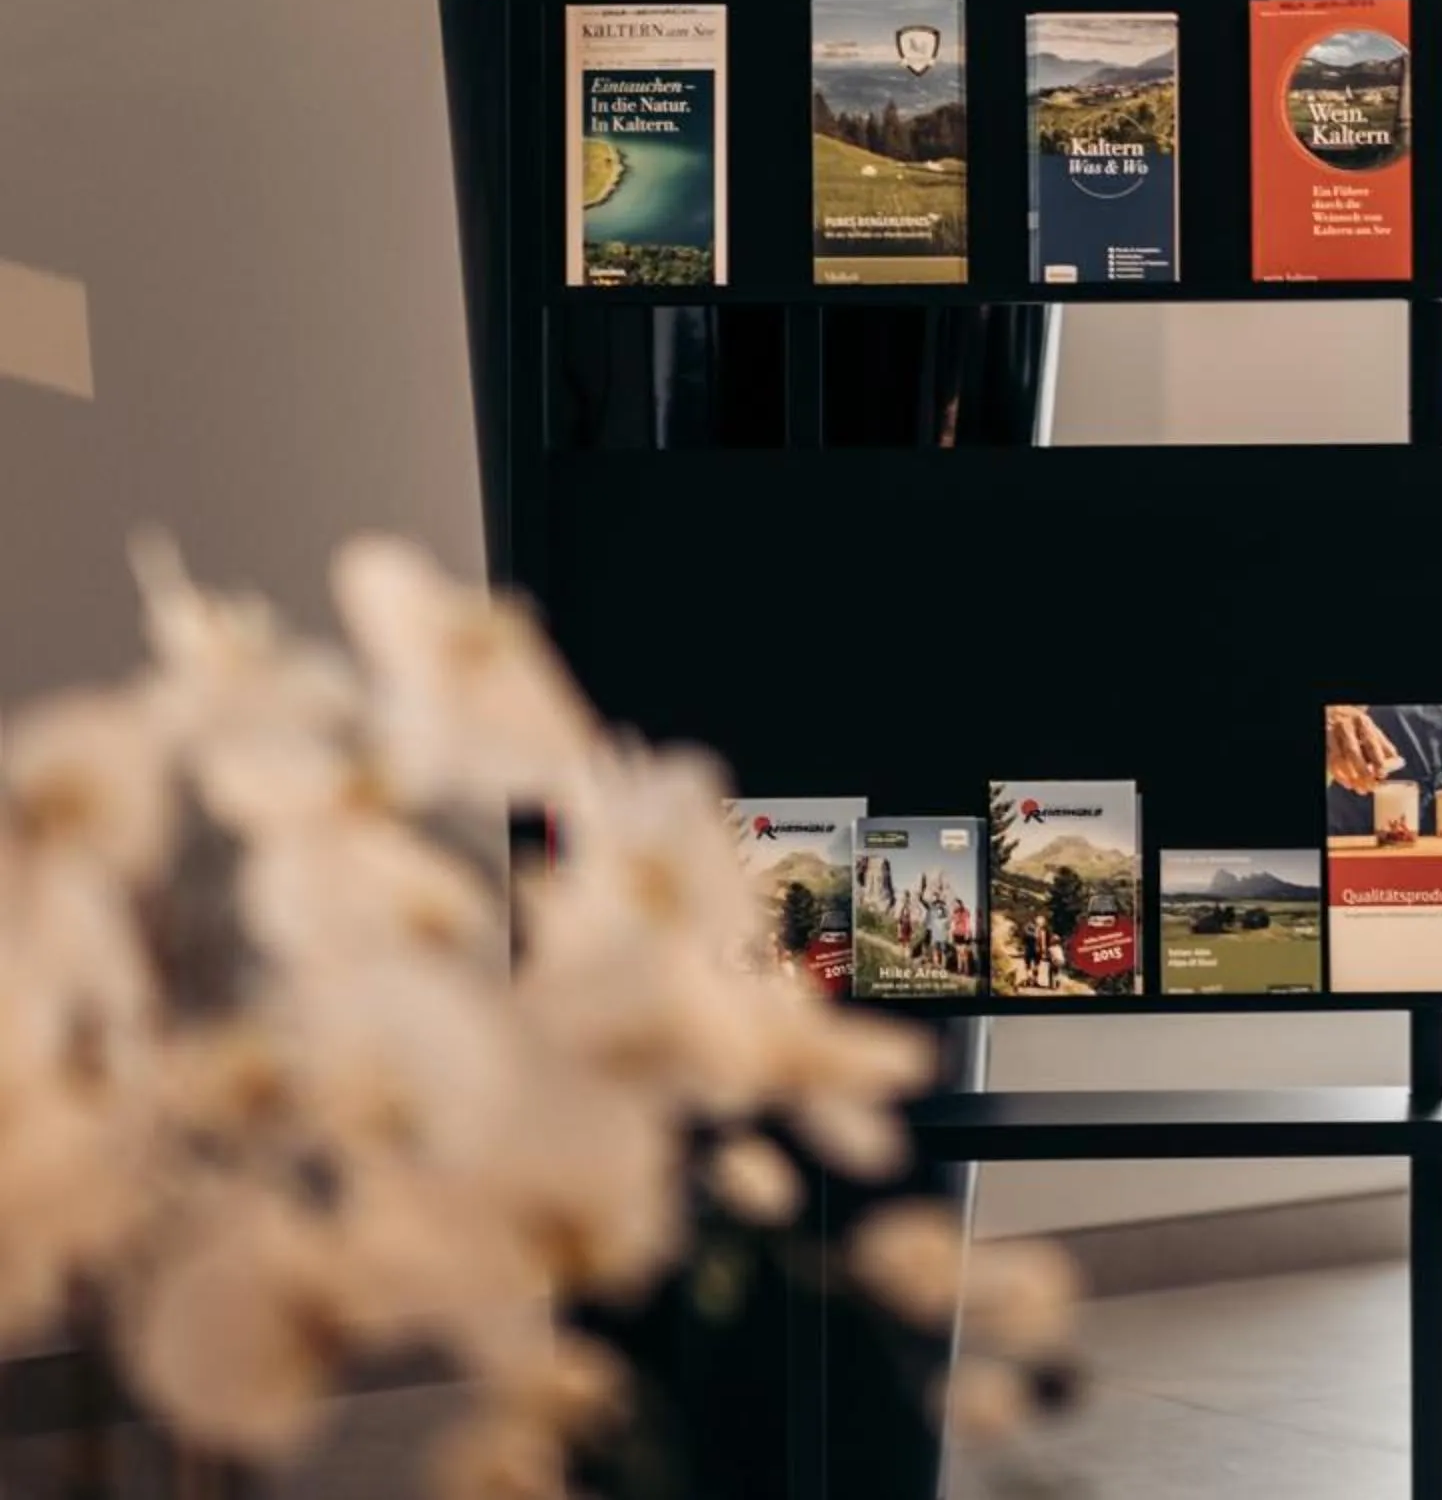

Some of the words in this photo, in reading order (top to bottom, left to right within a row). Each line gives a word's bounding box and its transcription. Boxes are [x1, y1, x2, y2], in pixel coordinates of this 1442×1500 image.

[591, 77, 682, 93] Eintauchen
[591, 98, 608, 112] In
[611, 97, 637, 112] die
[641, 97, 691, 113] Natur.
[1308, 103, 1368, 123] Wein.
[591, 117, 608, 132] In
[612, 116, 680, 132] Kaltern.
[1311, 125, 1391, 145] Kaltern
[1071, 137, 1144, 157] Kaltern
[1069, 159, 1102, 175] Was
[1104, 159, 1119, 175] &
[1122, 159, 1149, 175] Wo
[1312, 185, 1331, 197] Ein
[1333, 185, 1369, 198] Führer
[1313, 224, 1353, 236] Kaltern
[1091, 948, 1123, 964] 2015
[879, 966, 911, 980] Hike
[914, 966, 949, 980] Area
